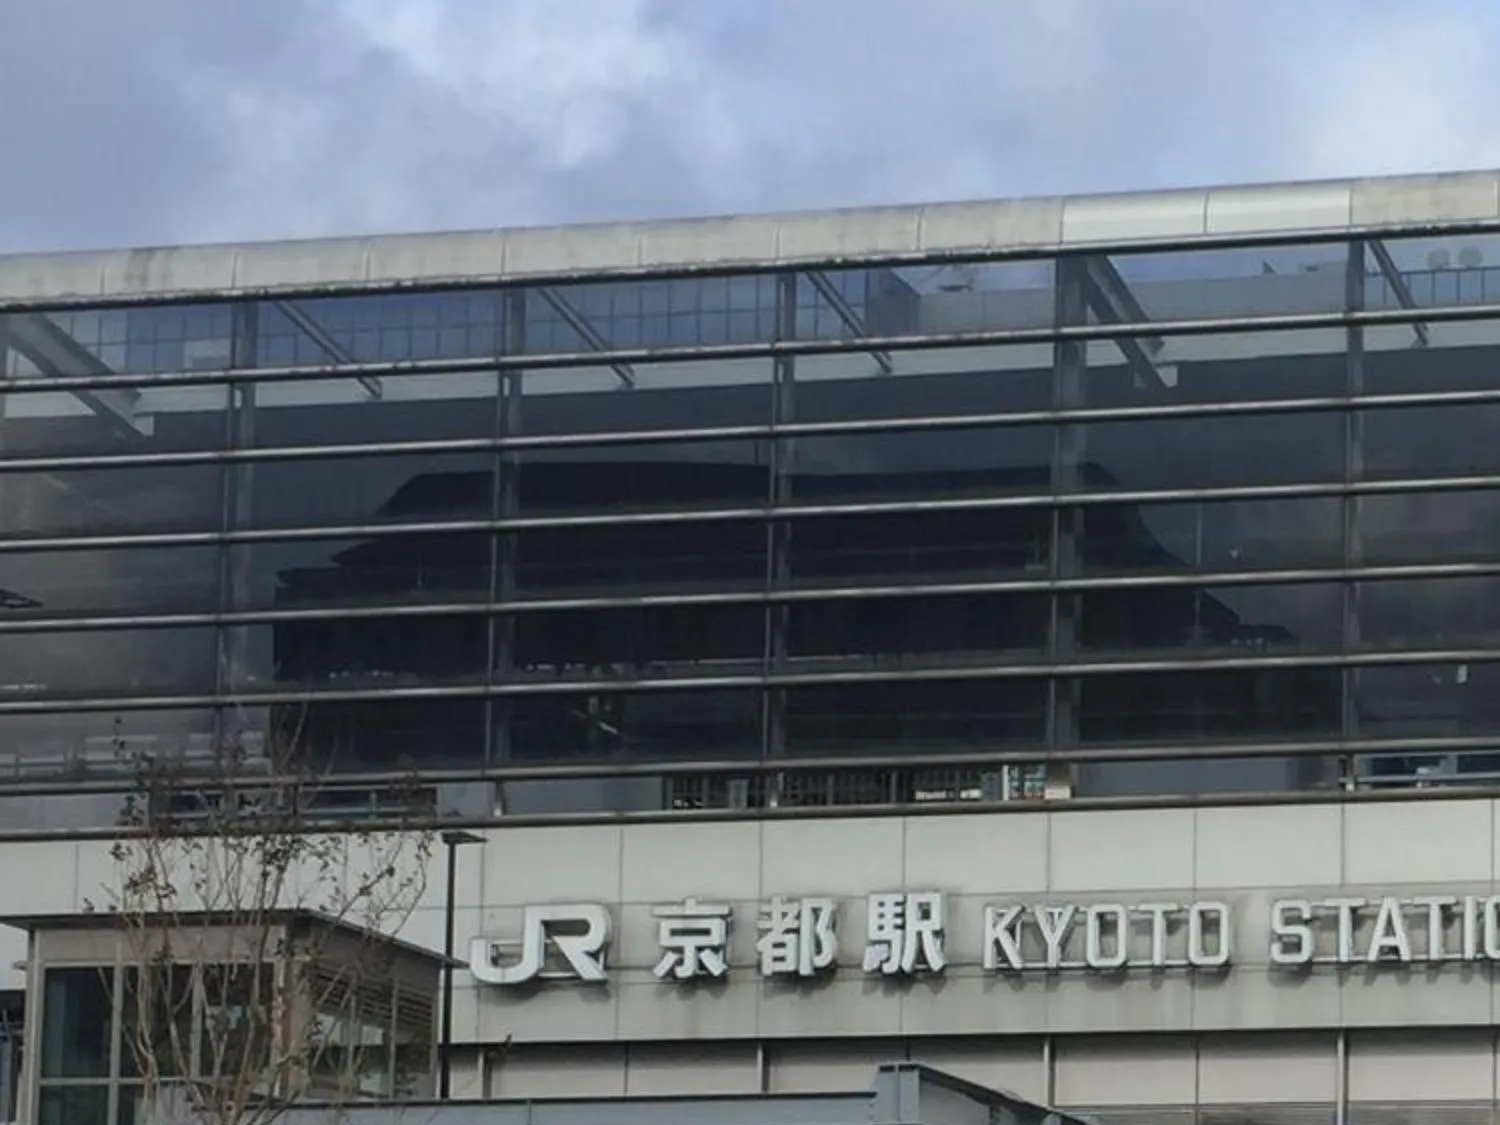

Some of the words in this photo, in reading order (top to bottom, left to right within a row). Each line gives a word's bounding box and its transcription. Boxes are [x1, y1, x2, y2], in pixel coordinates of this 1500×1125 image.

[469, 904, 609, 984] JR
[650, 890, 948, 979] 京都駅
[983, 901, 1231, 969] KYOTO
